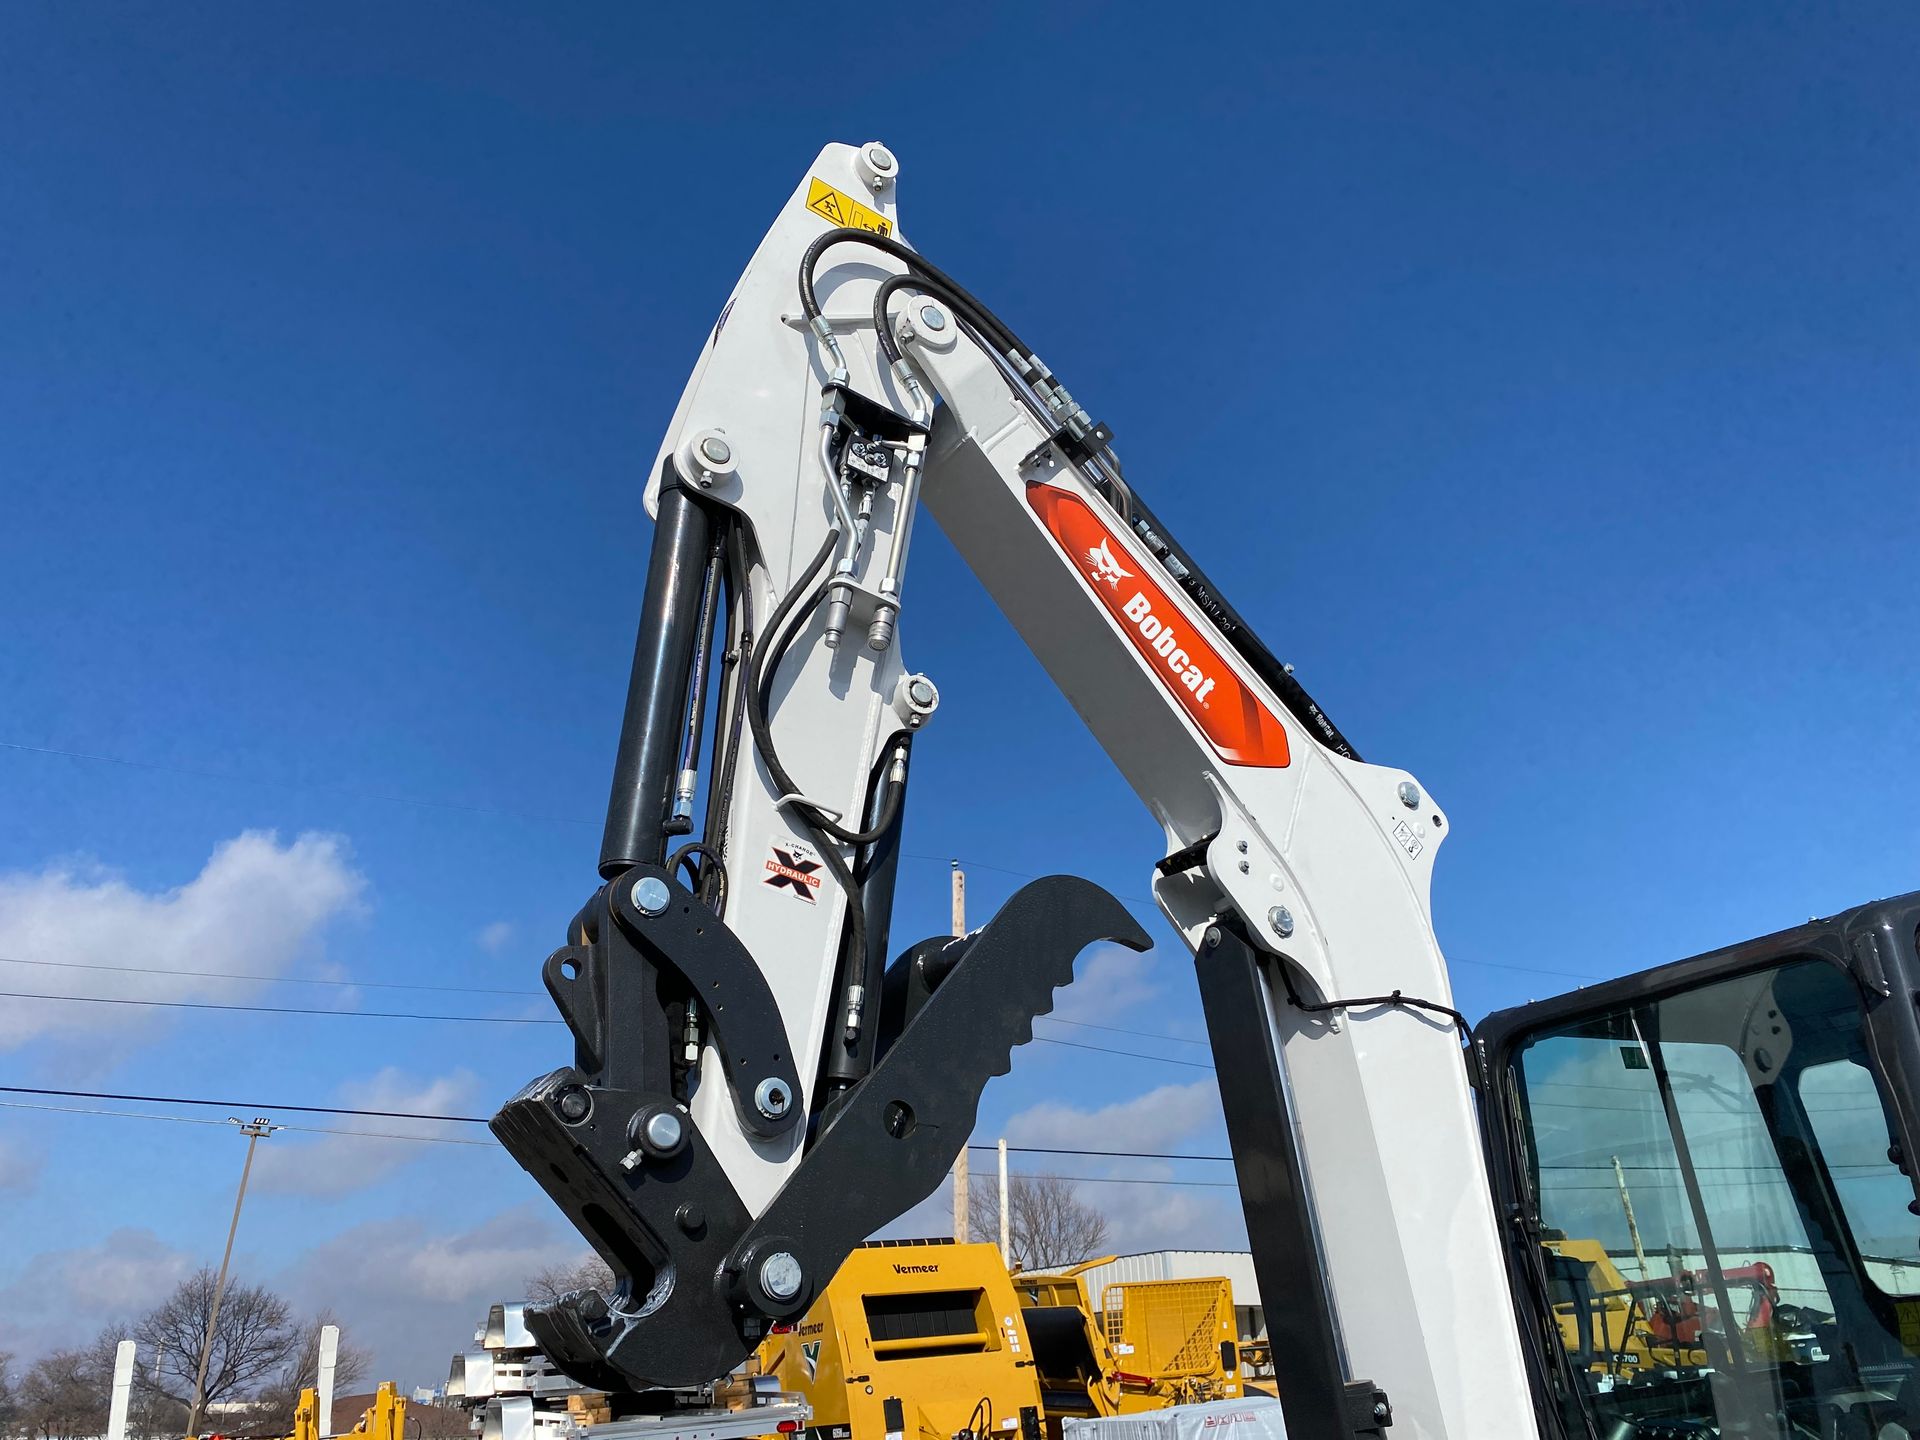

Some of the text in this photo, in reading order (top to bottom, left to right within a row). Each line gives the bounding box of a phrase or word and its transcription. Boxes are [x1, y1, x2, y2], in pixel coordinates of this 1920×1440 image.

[1121, 591, 1216, 704] Bobcat
[1315, 713, 1335, 739] Bobcat
[767, 861, 819, 887] HYDRAULIC
[892, 1263, 939, 1275] Vermeer
